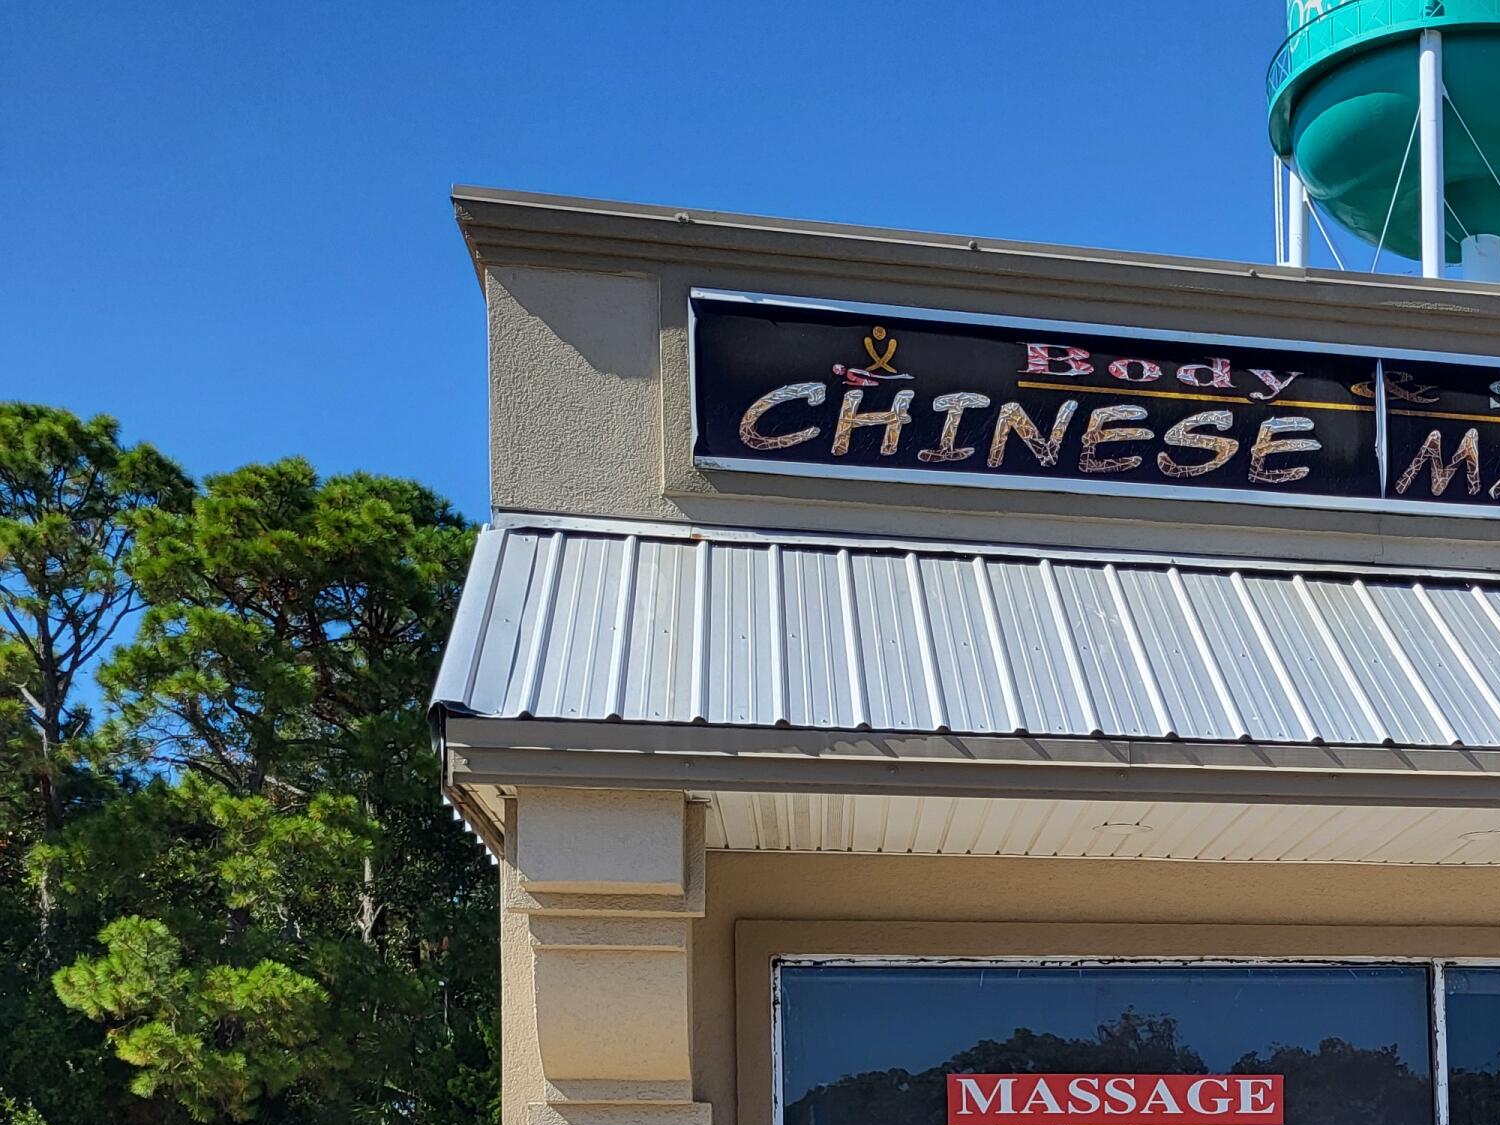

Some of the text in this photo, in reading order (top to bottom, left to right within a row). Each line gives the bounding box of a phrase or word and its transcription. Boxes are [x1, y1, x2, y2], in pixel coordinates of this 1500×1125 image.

[1019, 341, 1304, 400] Body
[739, 383, 1322, 484] CHINESE
[956, 1077, 1275, 1115] MASSAGE
